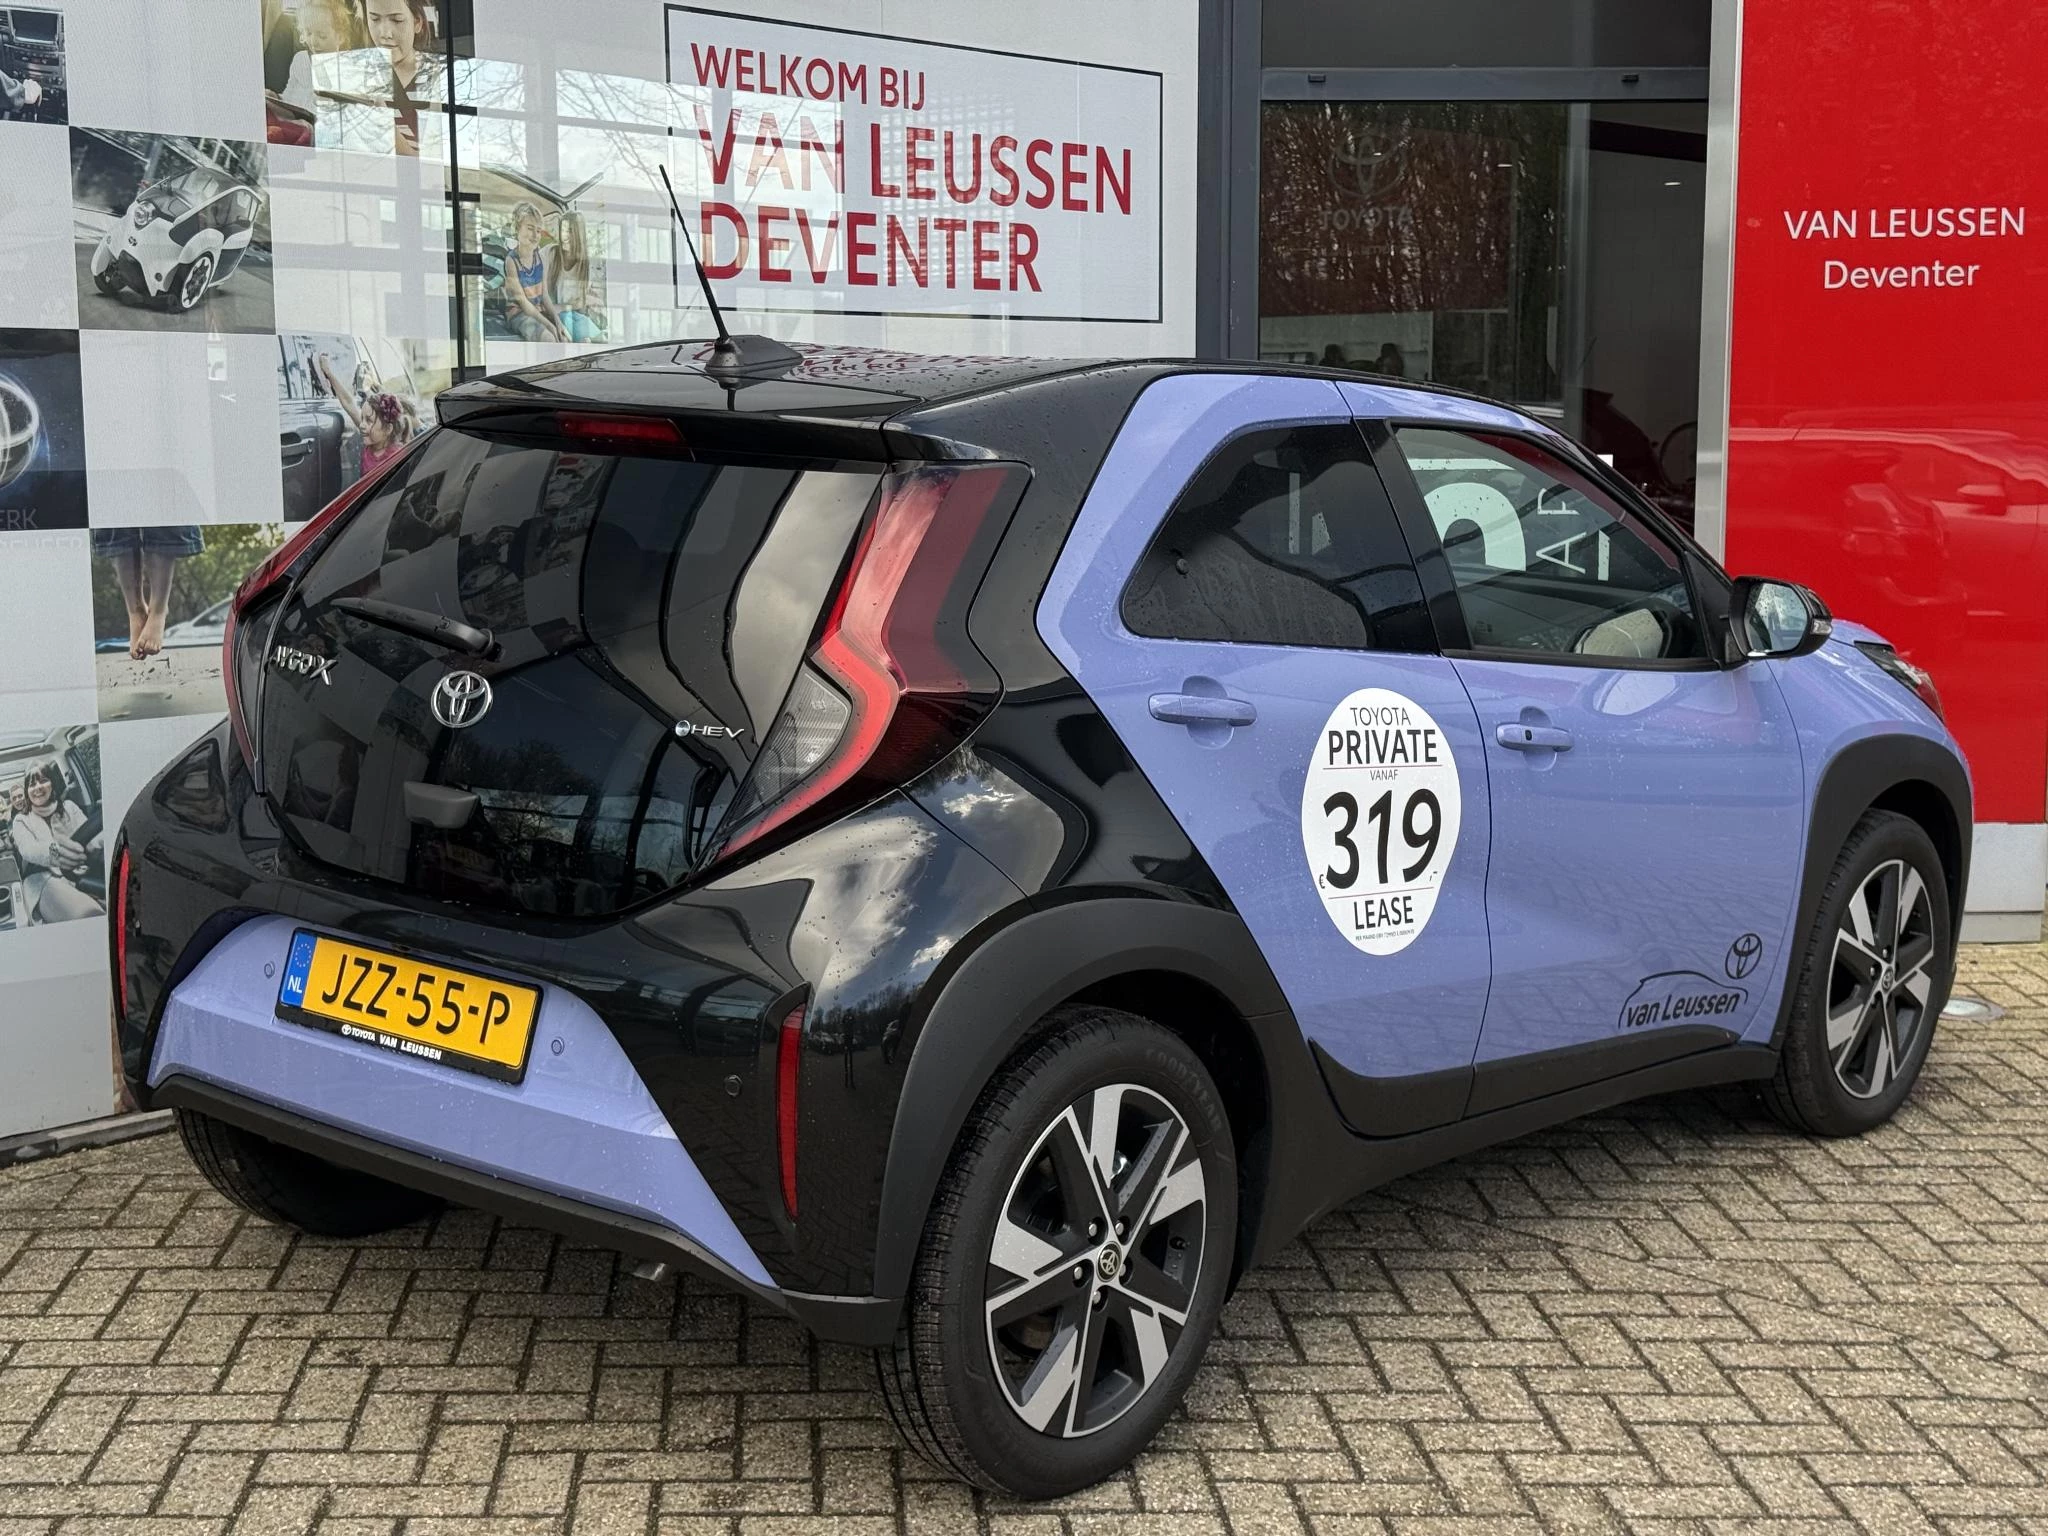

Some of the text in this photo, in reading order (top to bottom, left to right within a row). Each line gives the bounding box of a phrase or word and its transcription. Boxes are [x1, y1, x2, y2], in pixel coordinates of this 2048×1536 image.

[691, 42, 925, 111] WELKOM BIJ
[694, 104, 1132, 216] VAN LEUSSEN
[1783, 207, 2025, 239] VAN LEUSSEN
[699, 201, 1043, 293] DEVENTER
[1823, 260, 1980, 289] Deventer
[691, 724, 745, 739] HEV
[1350, 707, 1411, 727] TOYOTA
[1328, 729, 1438, 765] PRIVATE
[1370, 769, 1399, 781] VANAF
[1354, 896, 1414, 931] LEASE
[287, 974, 303, 994] NL
[321, 953, 512, 1044] JZZ-55-P
[1626, 992, 1741, 1028] van Leussen
[351, 1027, 443, 1061] TOYOTA VAN LEUSSEN
